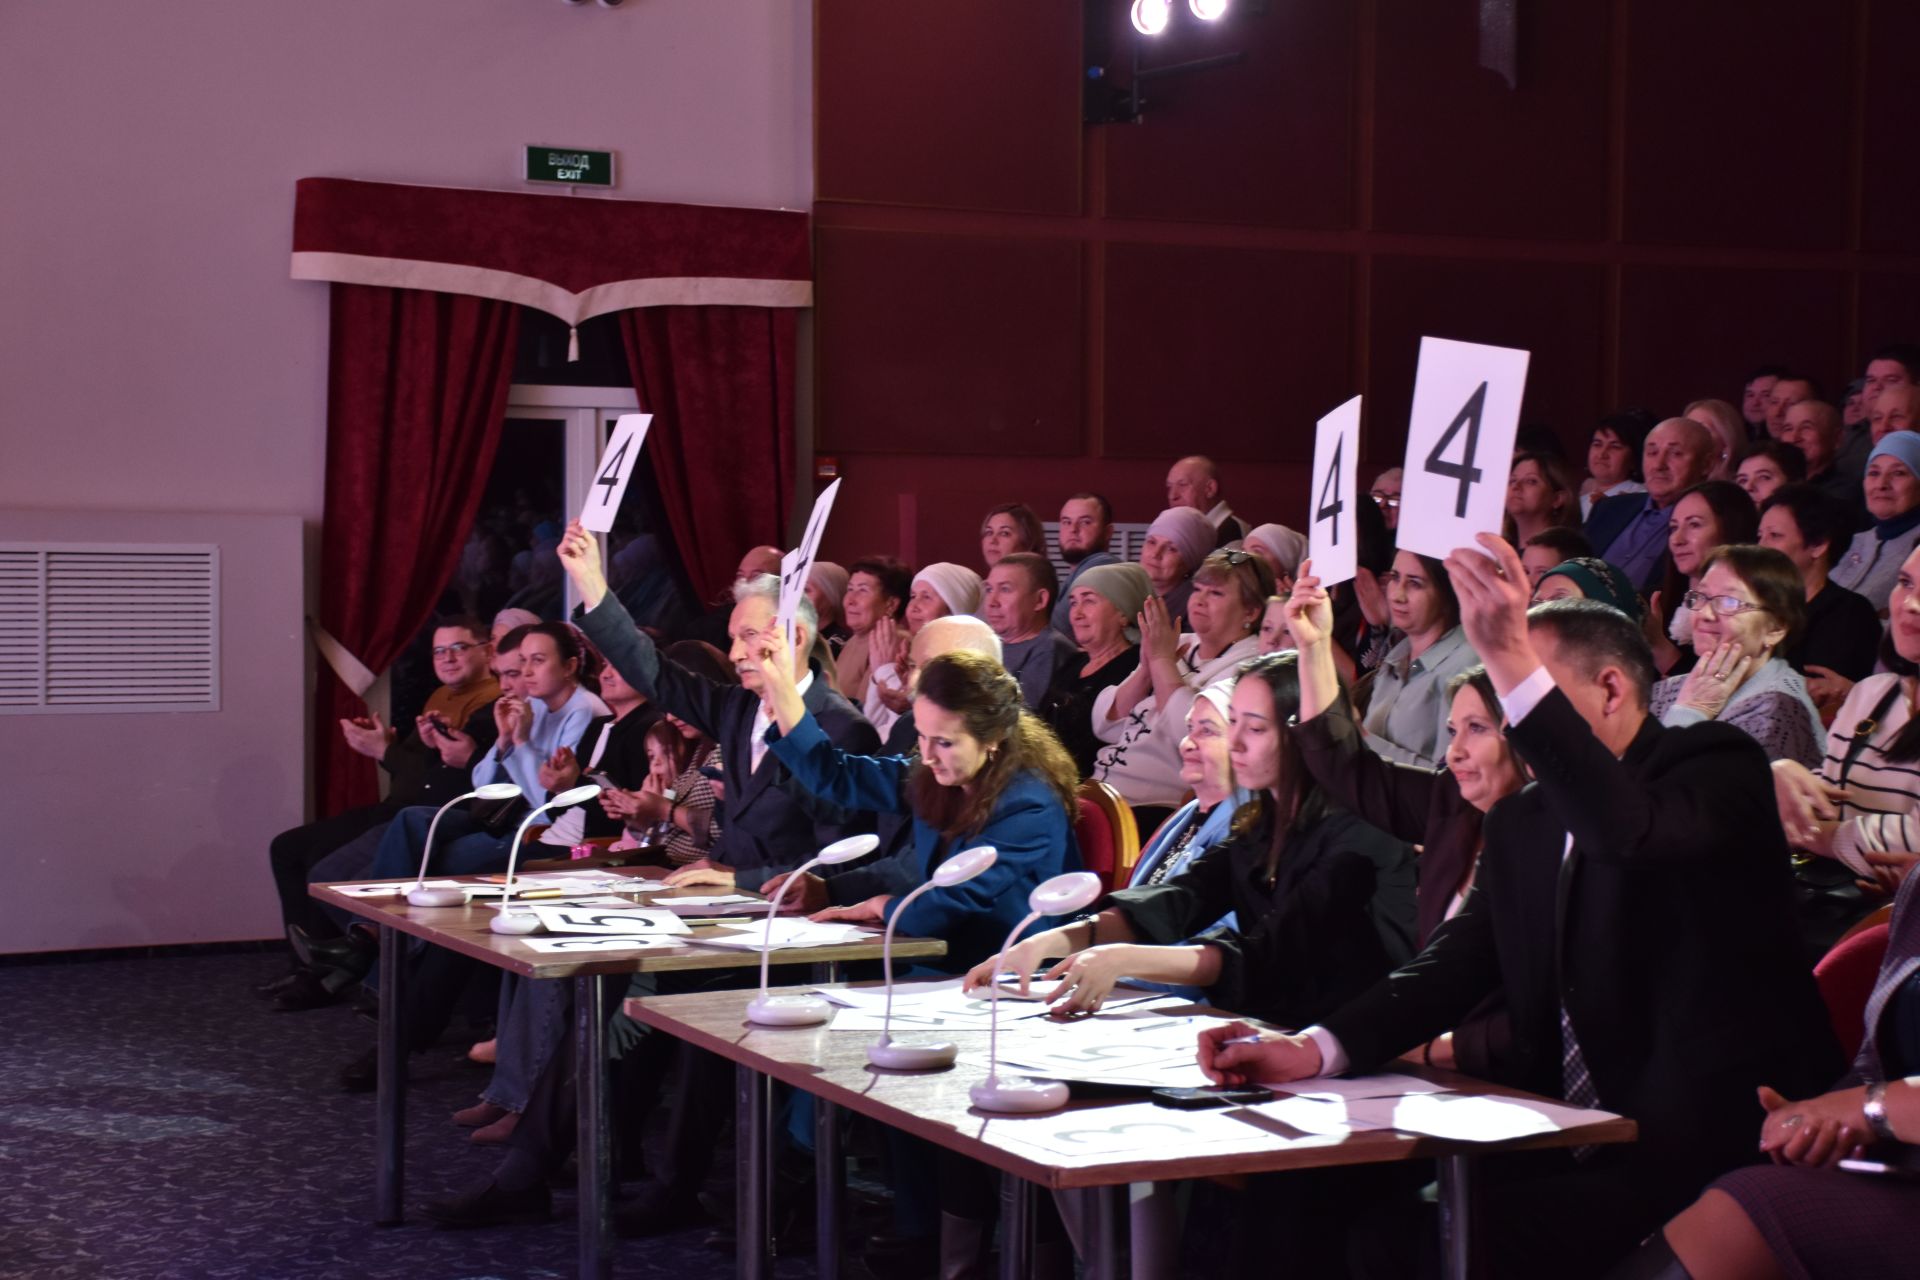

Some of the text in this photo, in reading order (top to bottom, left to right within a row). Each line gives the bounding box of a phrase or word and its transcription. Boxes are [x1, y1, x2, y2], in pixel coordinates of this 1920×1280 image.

[548, 153, 590, 170] ВЫХОД
[557, 168, 582, 179] EXIT
[1424, 381, 1488, 518] 4
[596, 431, 634, 506] 4
[1315, 430, 1343, 546] 4
[792, 504, 825, 592] 4
[559, 914, 655, 927] 5
[552, 939, 650, 948] 3
[1046, 1045, 1169, 1062] 5
[1053, 1123, 1195, 1143] 3
